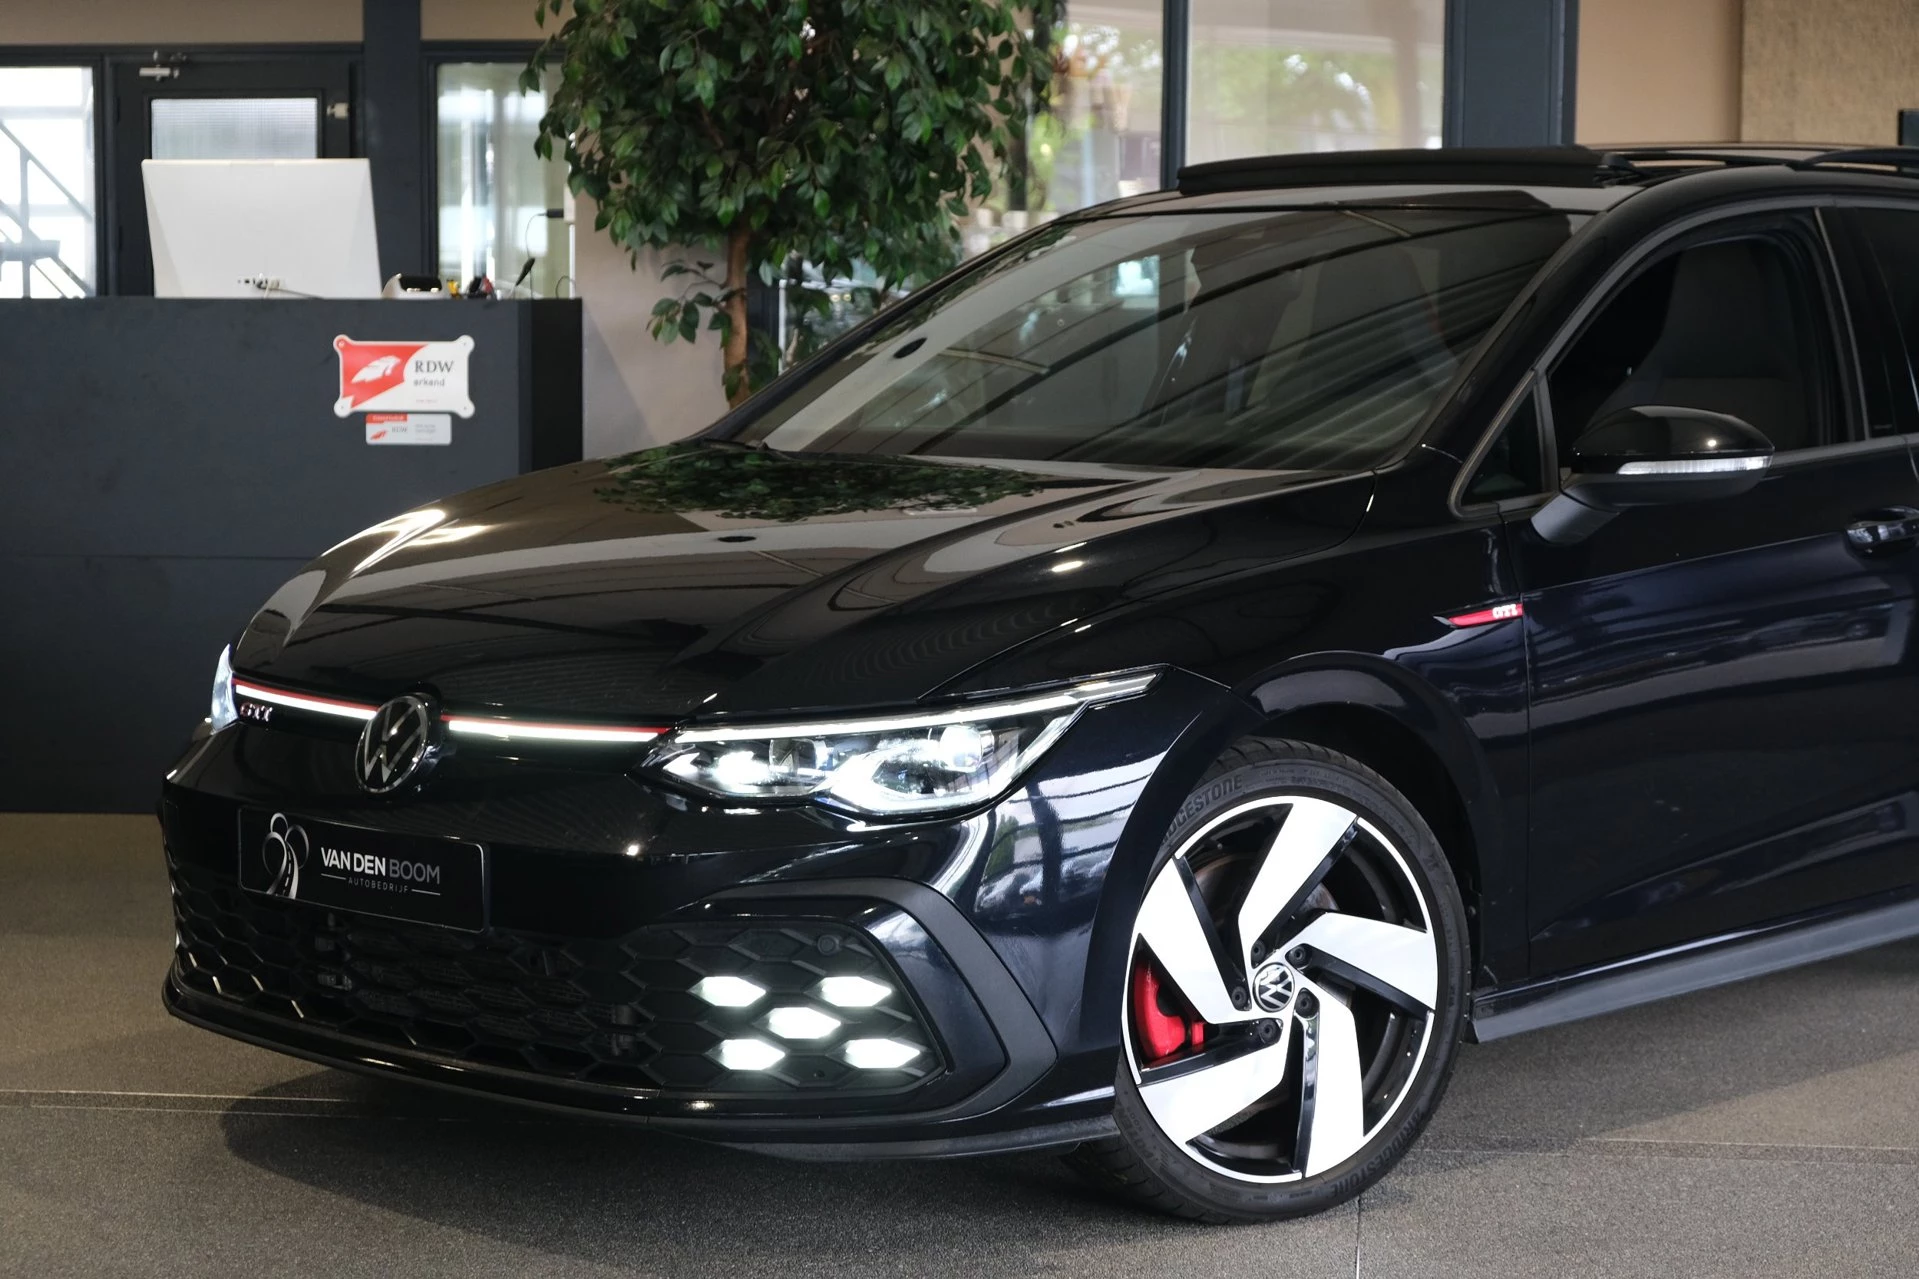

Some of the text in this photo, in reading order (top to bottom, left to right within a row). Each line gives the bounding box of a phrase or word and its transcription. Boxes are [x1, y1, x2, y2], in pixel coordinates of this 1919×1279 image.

[414, 360, 454, 373] RDW
[1492, 603, 1519, 619] GTI
[239, 702, 273, 722] GTI
[1163, 773, 1244, 844] DGESTONE
[320, 846, 440, 885] VAN DEN BOOM
[348, 876, 409, 894] AUTOBEDRIJF
